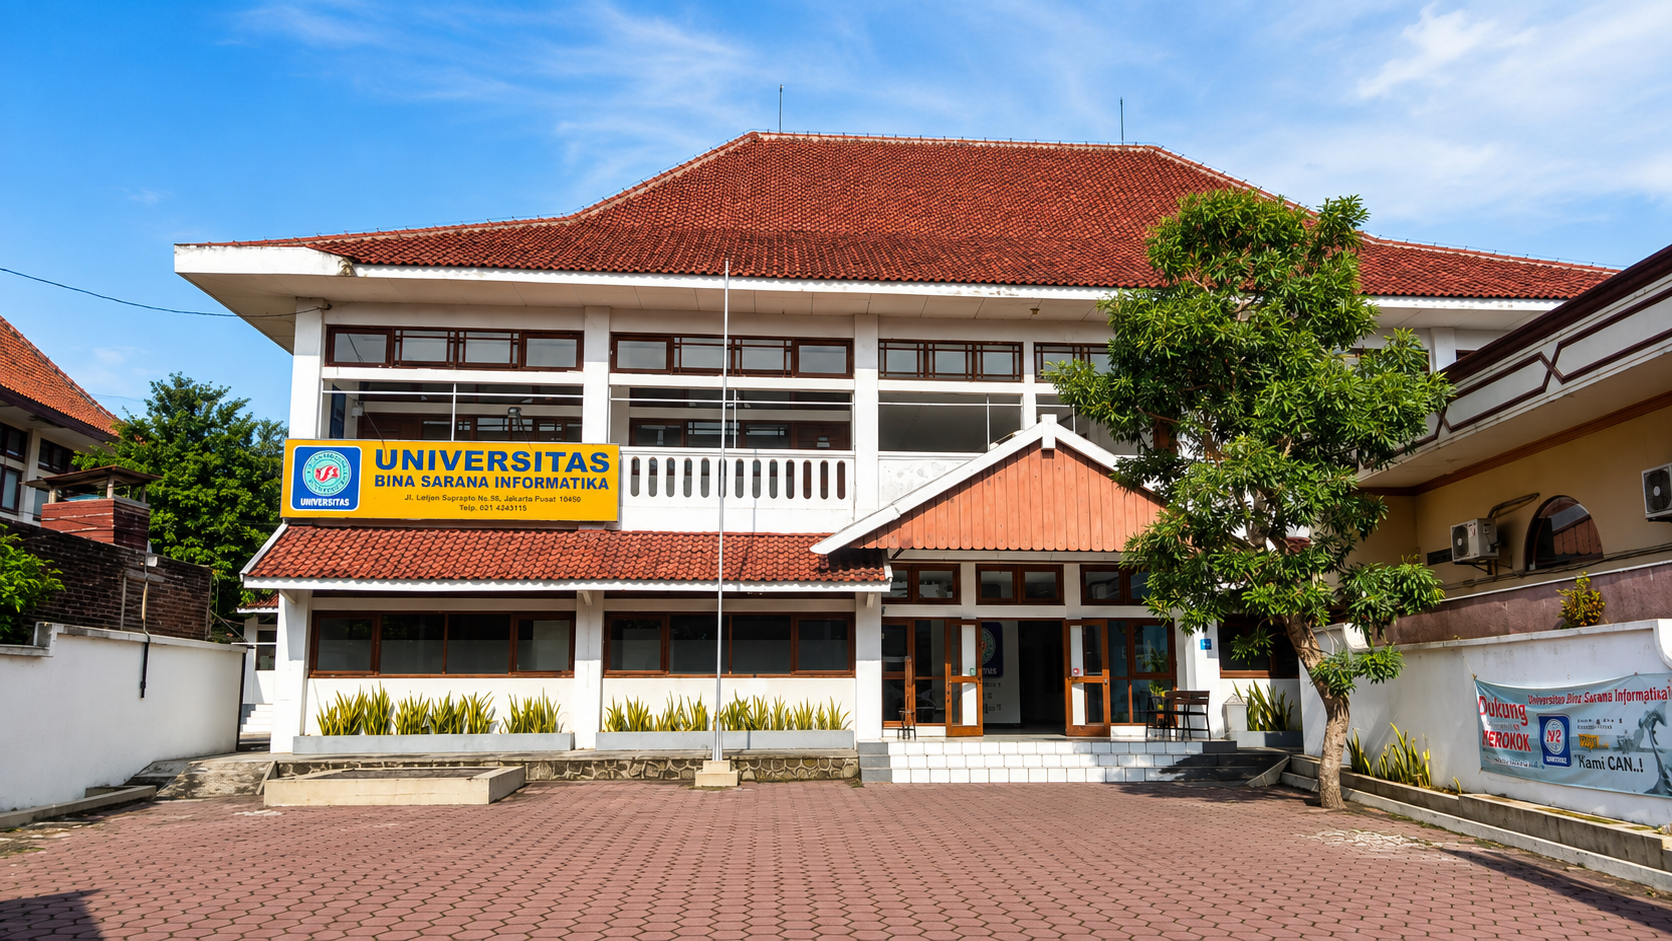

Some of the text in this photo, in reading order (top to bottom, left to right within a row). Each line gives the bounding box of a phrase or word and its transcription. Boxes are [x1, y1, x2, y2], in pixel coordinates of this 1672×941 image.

[375, 449, 610, 473] UNIVERSITAS
[374, 475, 610, 490] BINA SARANA INFORMATIKA
[300, 498, 350, 507] UNIVERSITAS
[1478, 695, 1529, 727] Dukung
